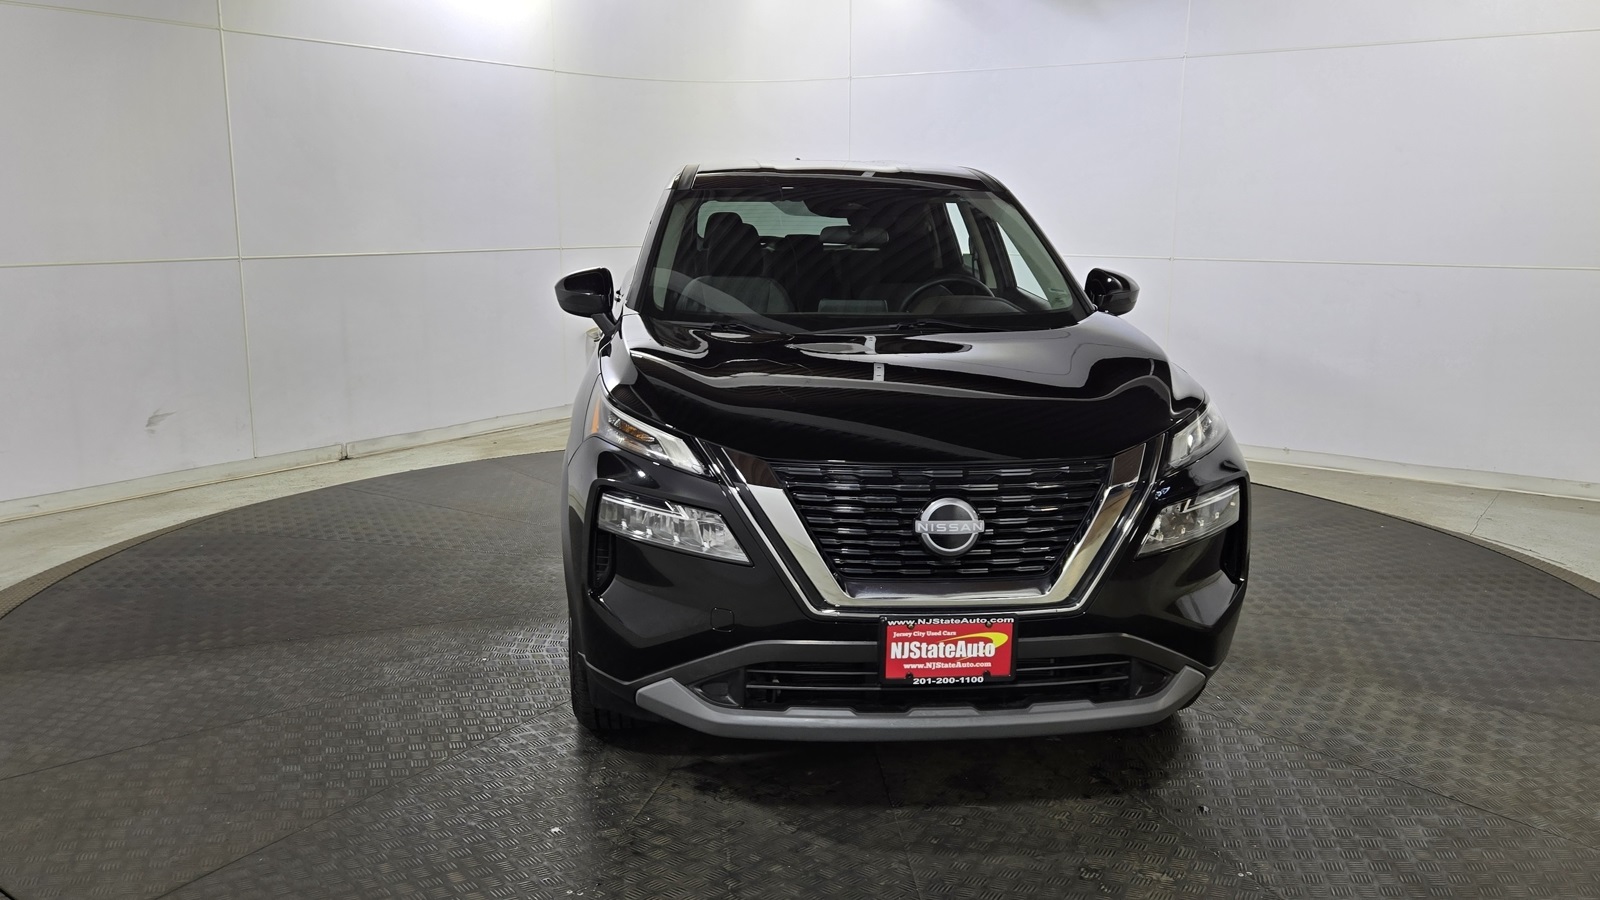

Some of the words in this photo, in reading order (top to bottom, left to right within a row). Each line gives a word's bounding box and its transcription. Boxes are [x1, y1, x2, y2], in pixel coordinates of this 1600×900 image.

[917, 522, 983, 532] NISSAN
[887, 617, 1015, 626] www.NJStateAuto.com
[890, 640, 996, 659] NJStateAuto
[903, 661, 992, 670] www.NJStateAuto.com
[912, 676, 984, 685] 201-200-1100
